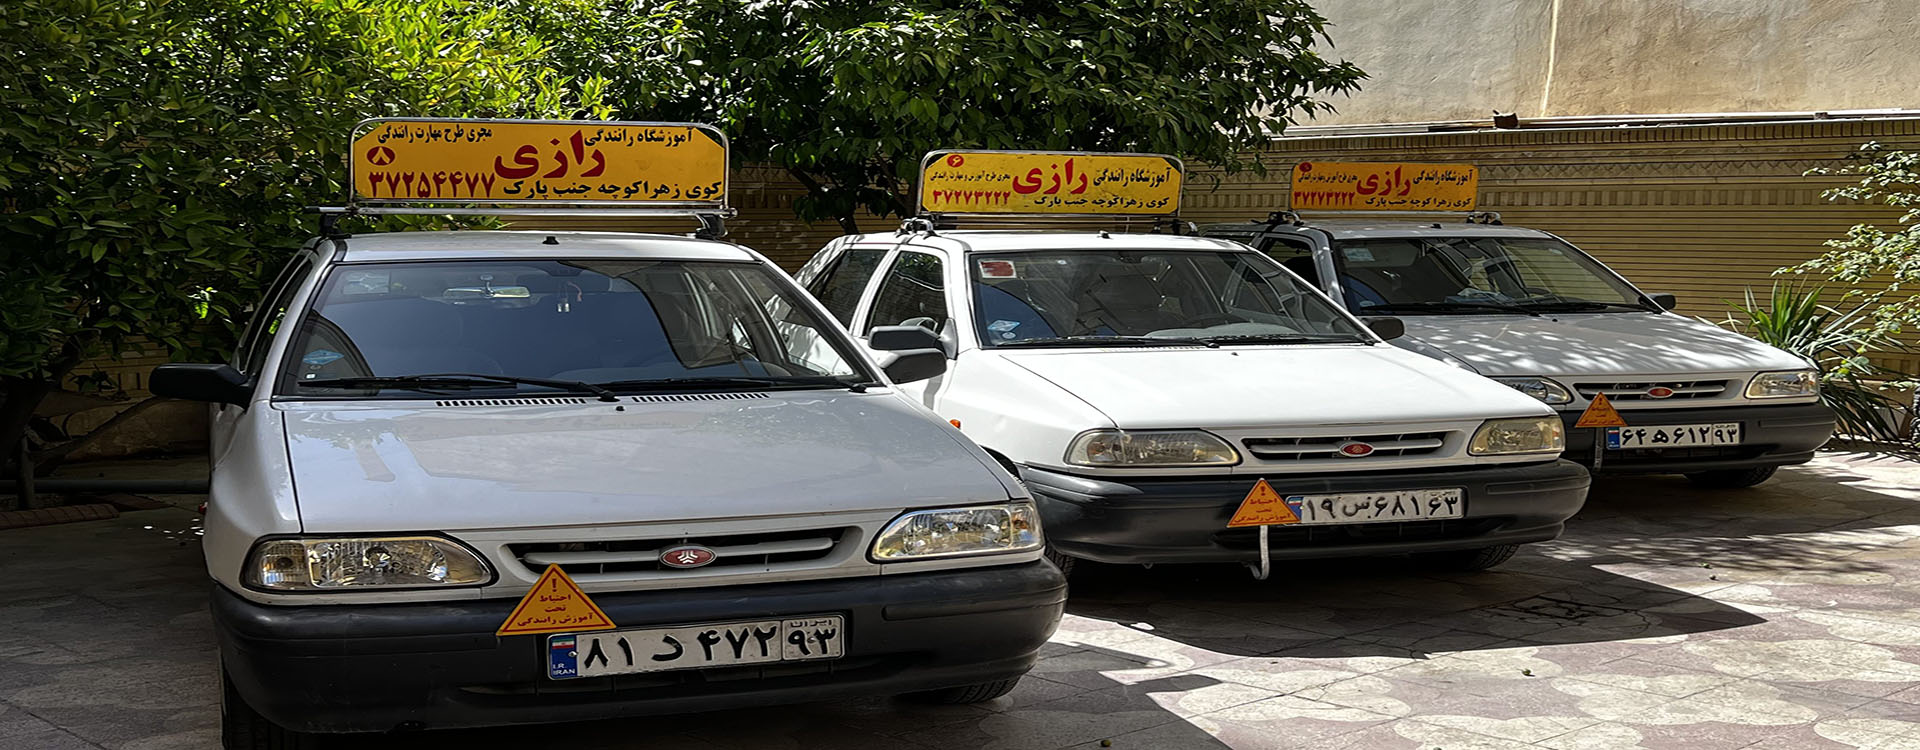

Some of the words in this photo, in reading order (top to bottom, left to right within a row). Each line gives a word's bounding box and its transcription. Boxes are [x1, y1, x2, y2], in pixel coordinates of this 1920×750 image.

[377, 125, 414, 143] رانندگی
[415, 124, 442, 143] مهارت
[444, 124, 464, 143] طرح
[466, 127, 492, 143] مجری
[584, 128, 634, 147] رانندگی
[637, 126, 692, 147] آموزشگاه
[371, 146, 391, 164] ۸
[494, 129, 605, 180] رازی
[368, 170, 496, 198] ۳۷۲۵۴۴۷۷
[1012, 157, 1088, 195] رازی
[1093, 168, 1128, 188] رانندگی
[1130, 167, 1172, 188] آموزشگاه
[1356, 165, 1411, 196] رازی
[503, 180, 548, 199] پارک
[553, 182, 592, 198] جنب
[598, 181, 642, 199] کوچه
[643, 181, 680, 199] زهرا
[686, 181, 722, 199] کوی
[932, 189, 1011, 205] ۳۷۲۷۳۲۲۲
[1146, 197, 1170, 208] کوی
[1621, 428, 1647, 446] ۶۴
[1673, 426, 1710, 444] ۶۱۲
[1714, 428, 1737, 443] ۹۳
[1307, 498, 1336, 521] ۱۹
[1375, 495, 1420, 517] ۶۸۱
[1428, 496, 1458, 516] ۶۳
[539, 593, 571, 603] احتیاط
[544, 604, 567, 613] تحت
[559, 612, 593, 624] آموزش
[517, 616, 556, 627] رانندگی
[584, 637, 634, 669] ۸۱
[652, 635, 684, 662] د
[697, 625, 777, 661] ۴۷۲
[787, 627, 836, 656] ۹۳
